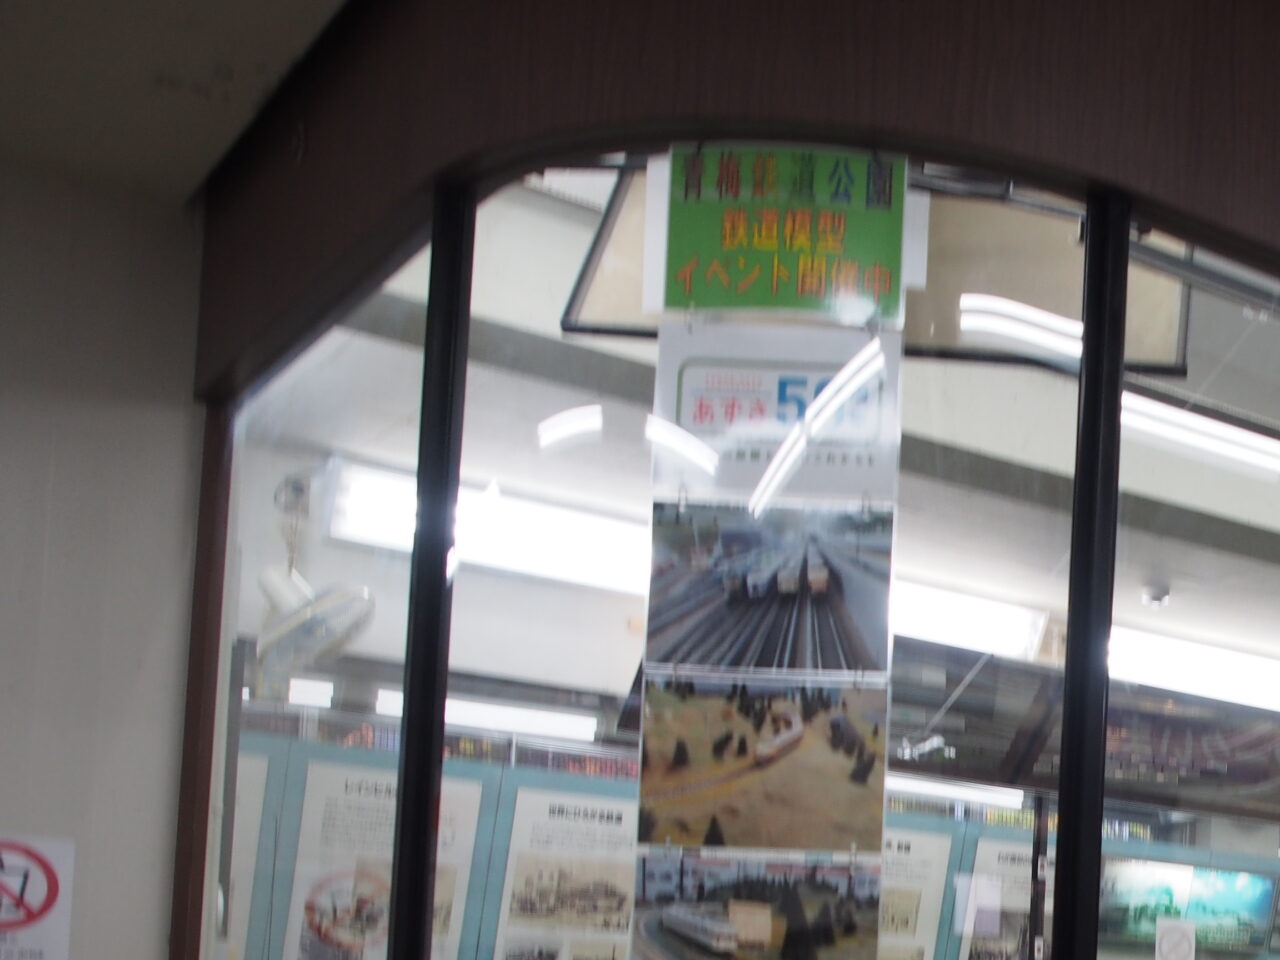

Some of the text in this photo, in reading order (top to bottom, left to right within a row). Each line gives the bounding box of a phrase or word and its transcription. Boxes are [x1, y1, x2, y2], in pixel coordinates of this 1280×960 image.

[721, 207, 846, 253] 鉄道模型
[676, 252, 892, 300] イベント開催中
